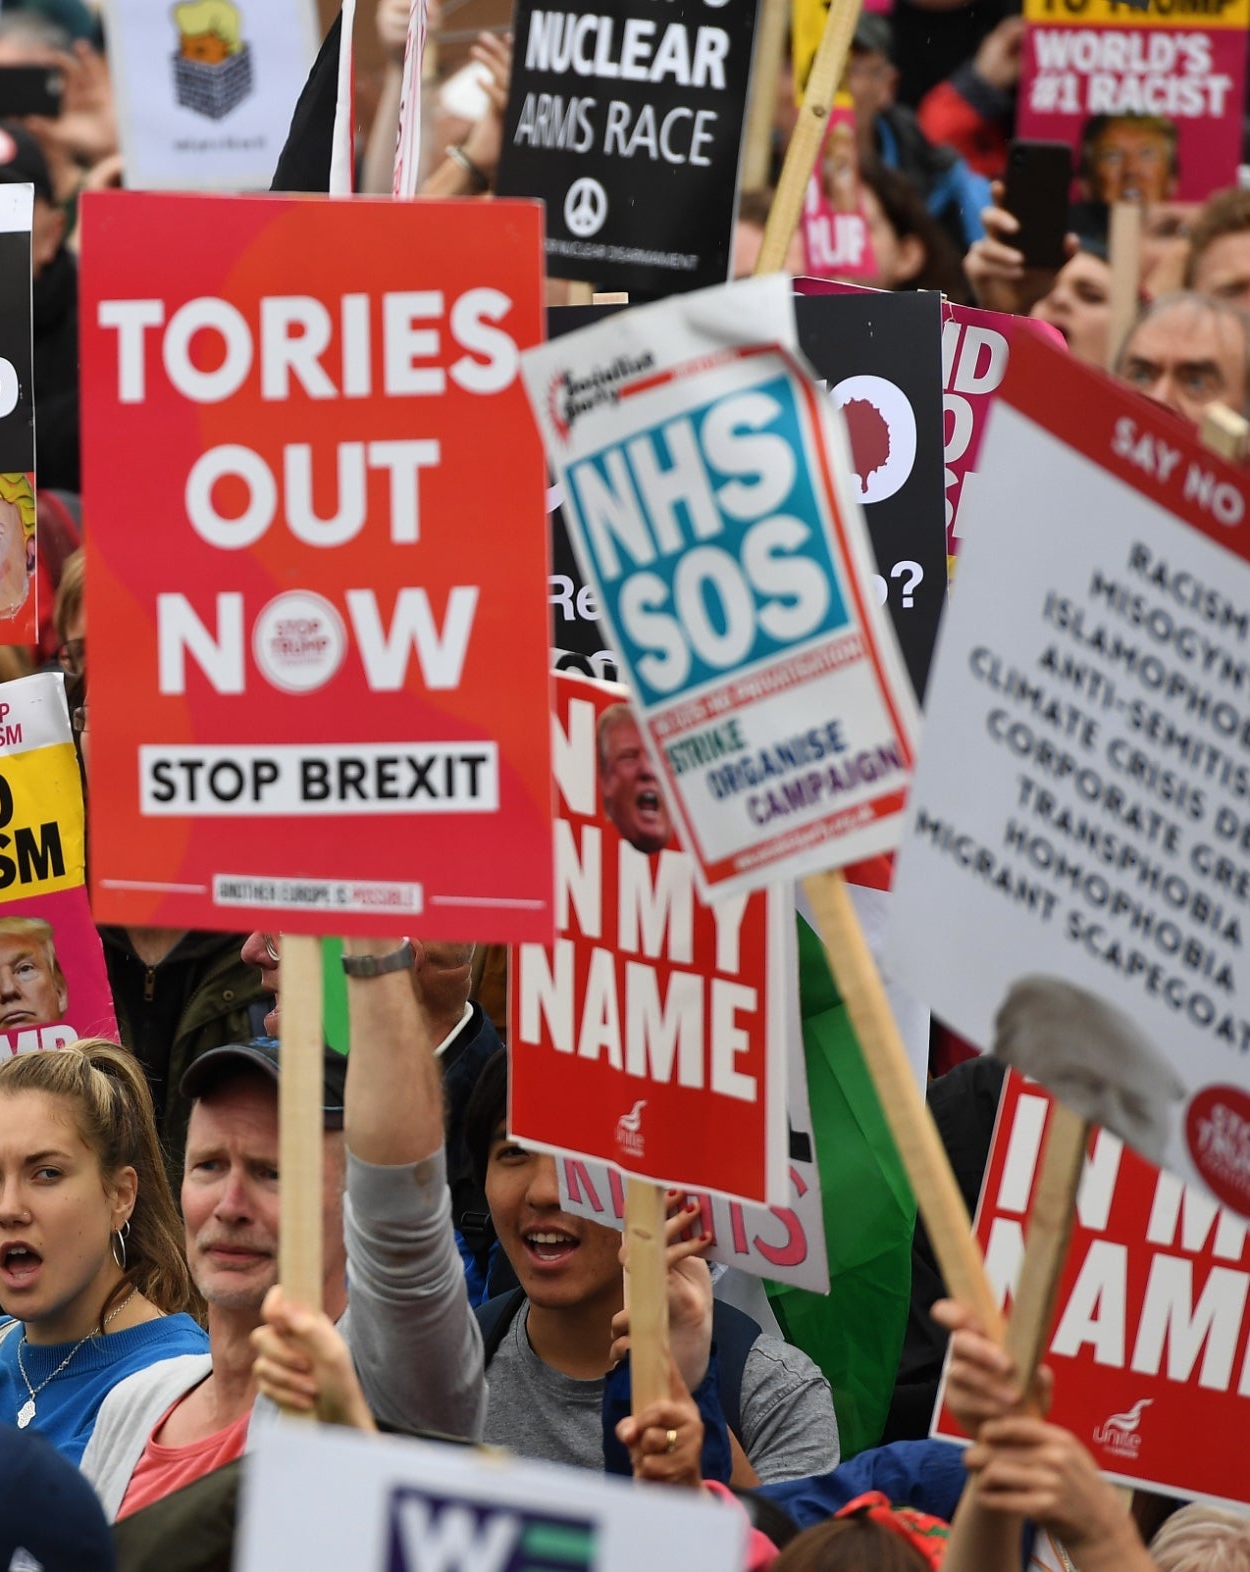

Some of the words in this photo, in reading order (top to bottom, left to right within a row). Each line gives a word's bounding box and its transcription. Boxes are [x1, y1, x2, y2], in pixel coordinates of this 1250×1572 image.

[525, 10, 731, 90] NUCLEAR
[1030, 71, 1081, 114] #1
[1087, 73, 1233, 118] RACIST
[1034, 29, 1212, 74] WORLD'S
[513, 92, 598, 154] ARMS
[604, 101, 718, 167] RACE
[97, 288, 520, 404] TORIES
[184, 439, 441, 551] OUT
[570, 391, 797, 582] NHS
[1111, 416, 1181, 484] SAY
[1185, 465, 1246, 526] NO
[618, 513, 830, 693] SOS
[1128, 541, 1250, 641] RACISM
[150, 756, 281, 803] STOP
[300, 753, 488, 802] BREXIT
[667, 717, 746, 775] STRIKE
[706, 719, 847, 801] ORGANISE
[746, 740, 905, 827] CAMPAIGN
[968, 646, 1098, 751] CLIMATE
[1106, 738, 1205, 821] CRISIS
[986, 707, 1181, 854] CORPORATE
[618, 838, 750, 975] MY
[915, 807, 1059, 924] MIGRANT
[1004, 818, 1236, 994] HOMOPHOBIA
[1018, 774, 1243, 949] TRANSPHOBIA
[519, 937, 757, 1102] NAME
[983, 1216, 1250, 1399] NAM
